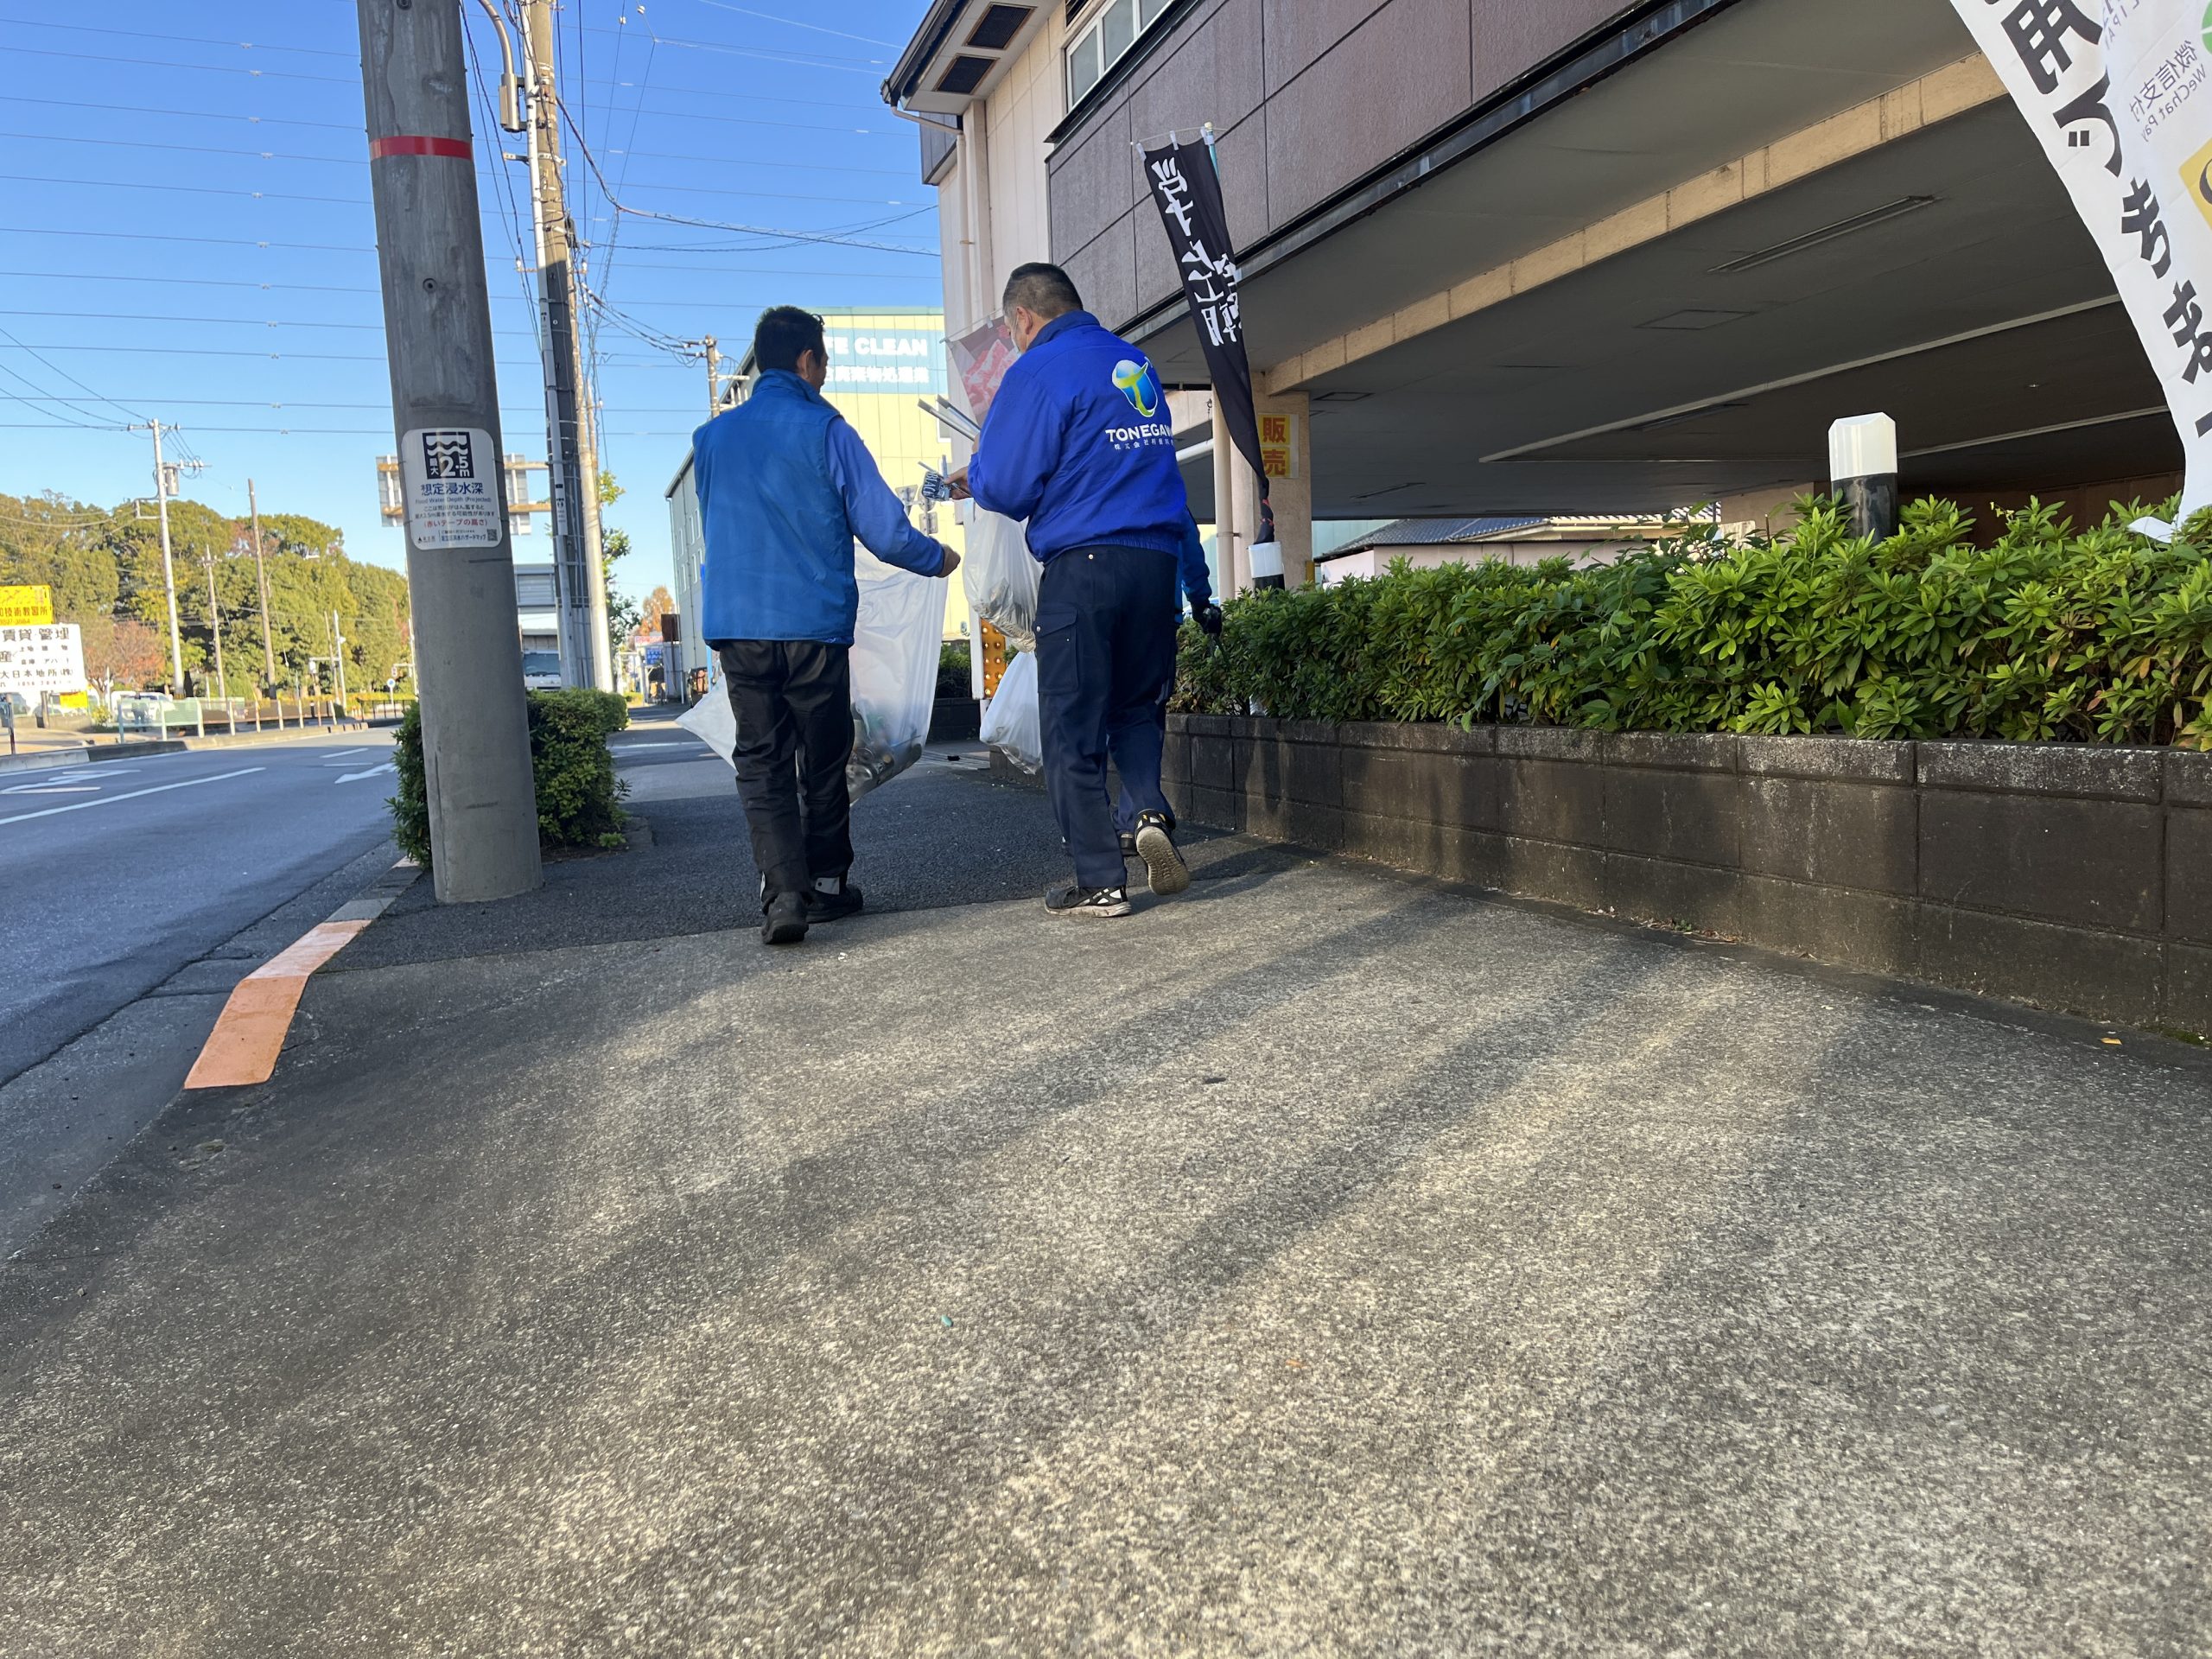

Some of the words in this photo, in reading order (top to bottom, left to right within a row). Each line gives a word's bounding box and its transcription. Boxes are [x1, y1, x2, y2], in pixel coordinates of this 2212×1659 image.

[855, 337, 927, 356] CLEAN
[1105, 423, 1173, 442] TONEGAW
[1262, 417, 1286, 475] 販売
[421, 482, 484, 495] 想定浸水深
